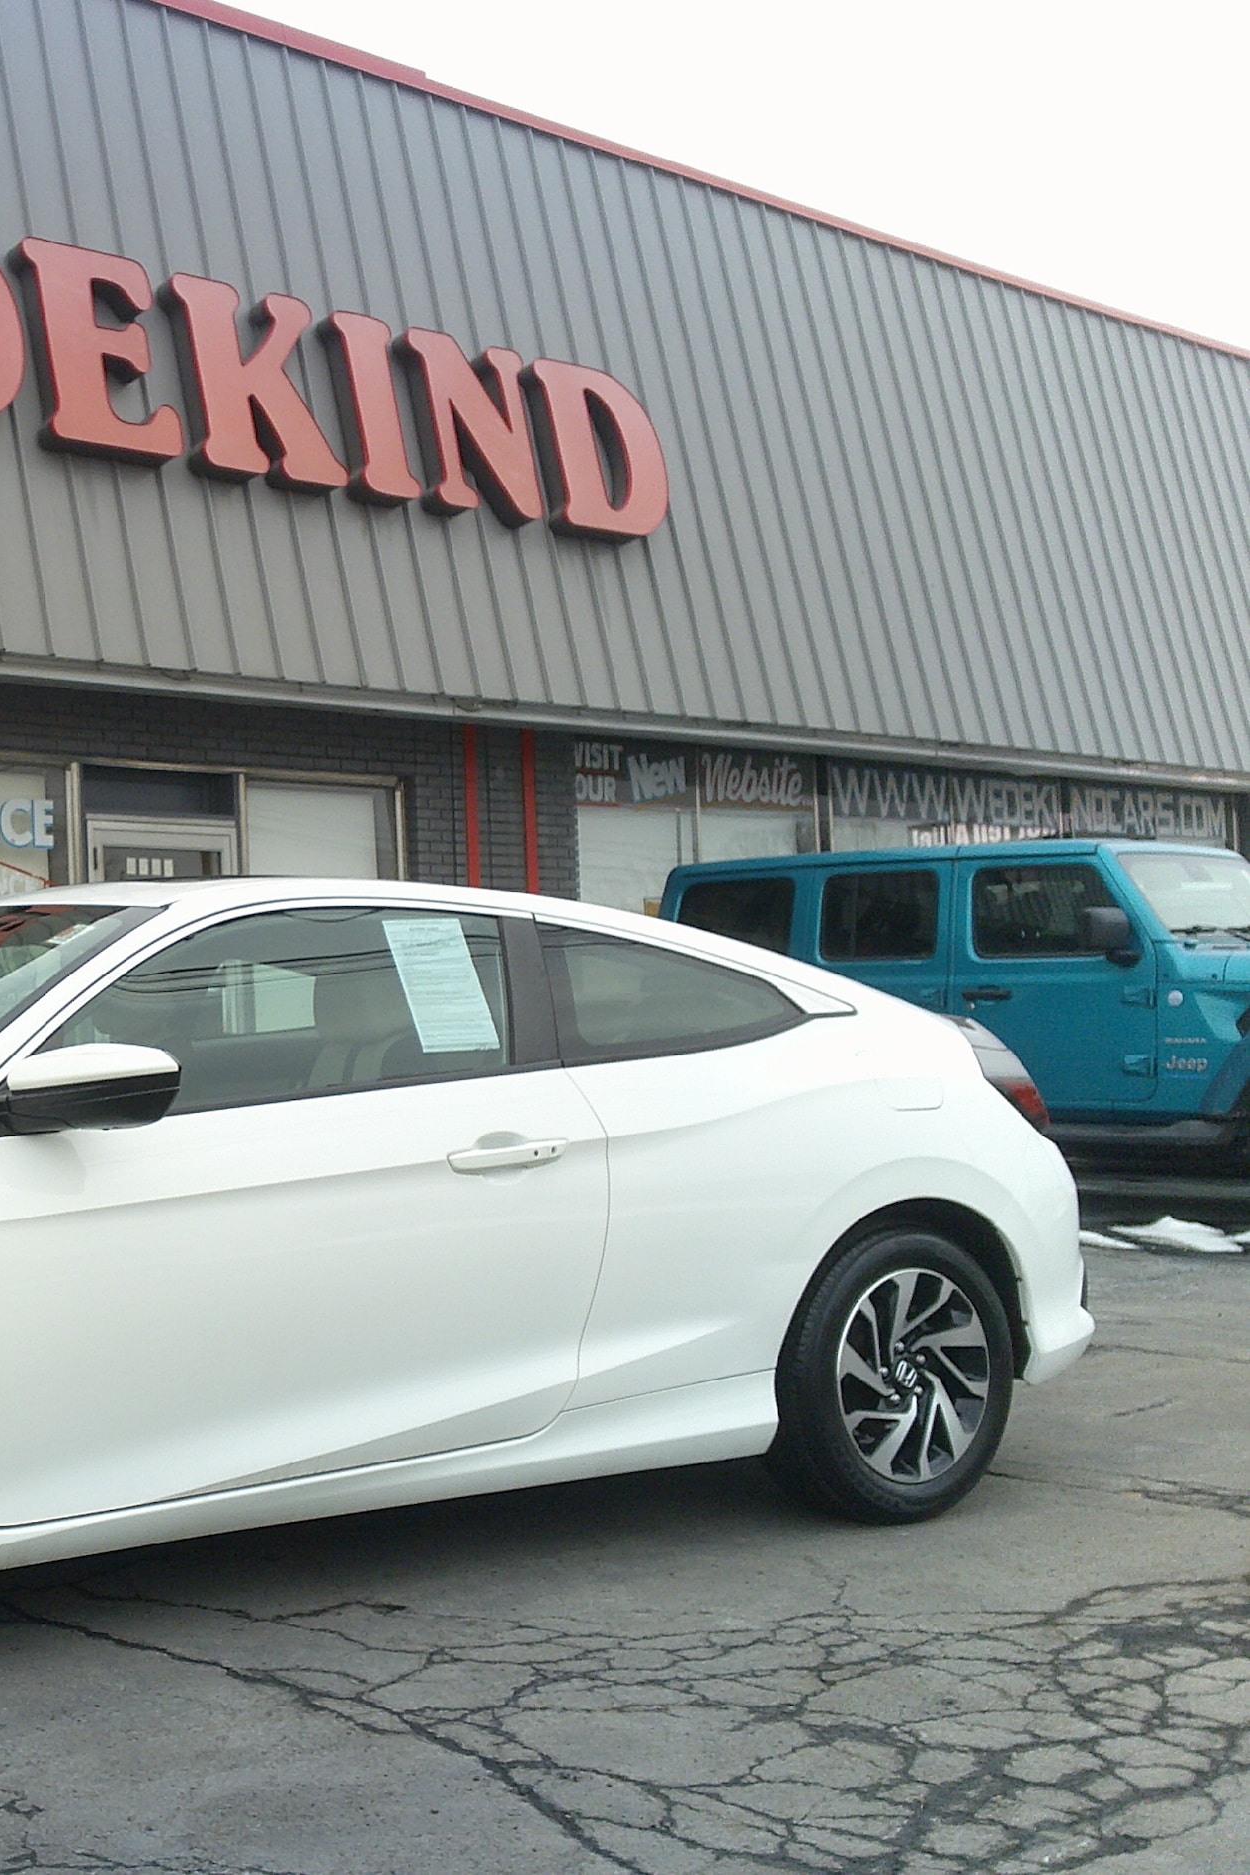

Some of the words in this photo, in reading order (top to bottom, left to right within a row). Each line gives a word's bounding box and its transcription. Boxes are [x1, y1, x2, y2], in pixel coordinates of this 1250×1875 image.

[575, 742, 623, 770] VISIT
[575, 773, 617, 802] OUR
[1165, 1055, 1208, 1072] Jeep
